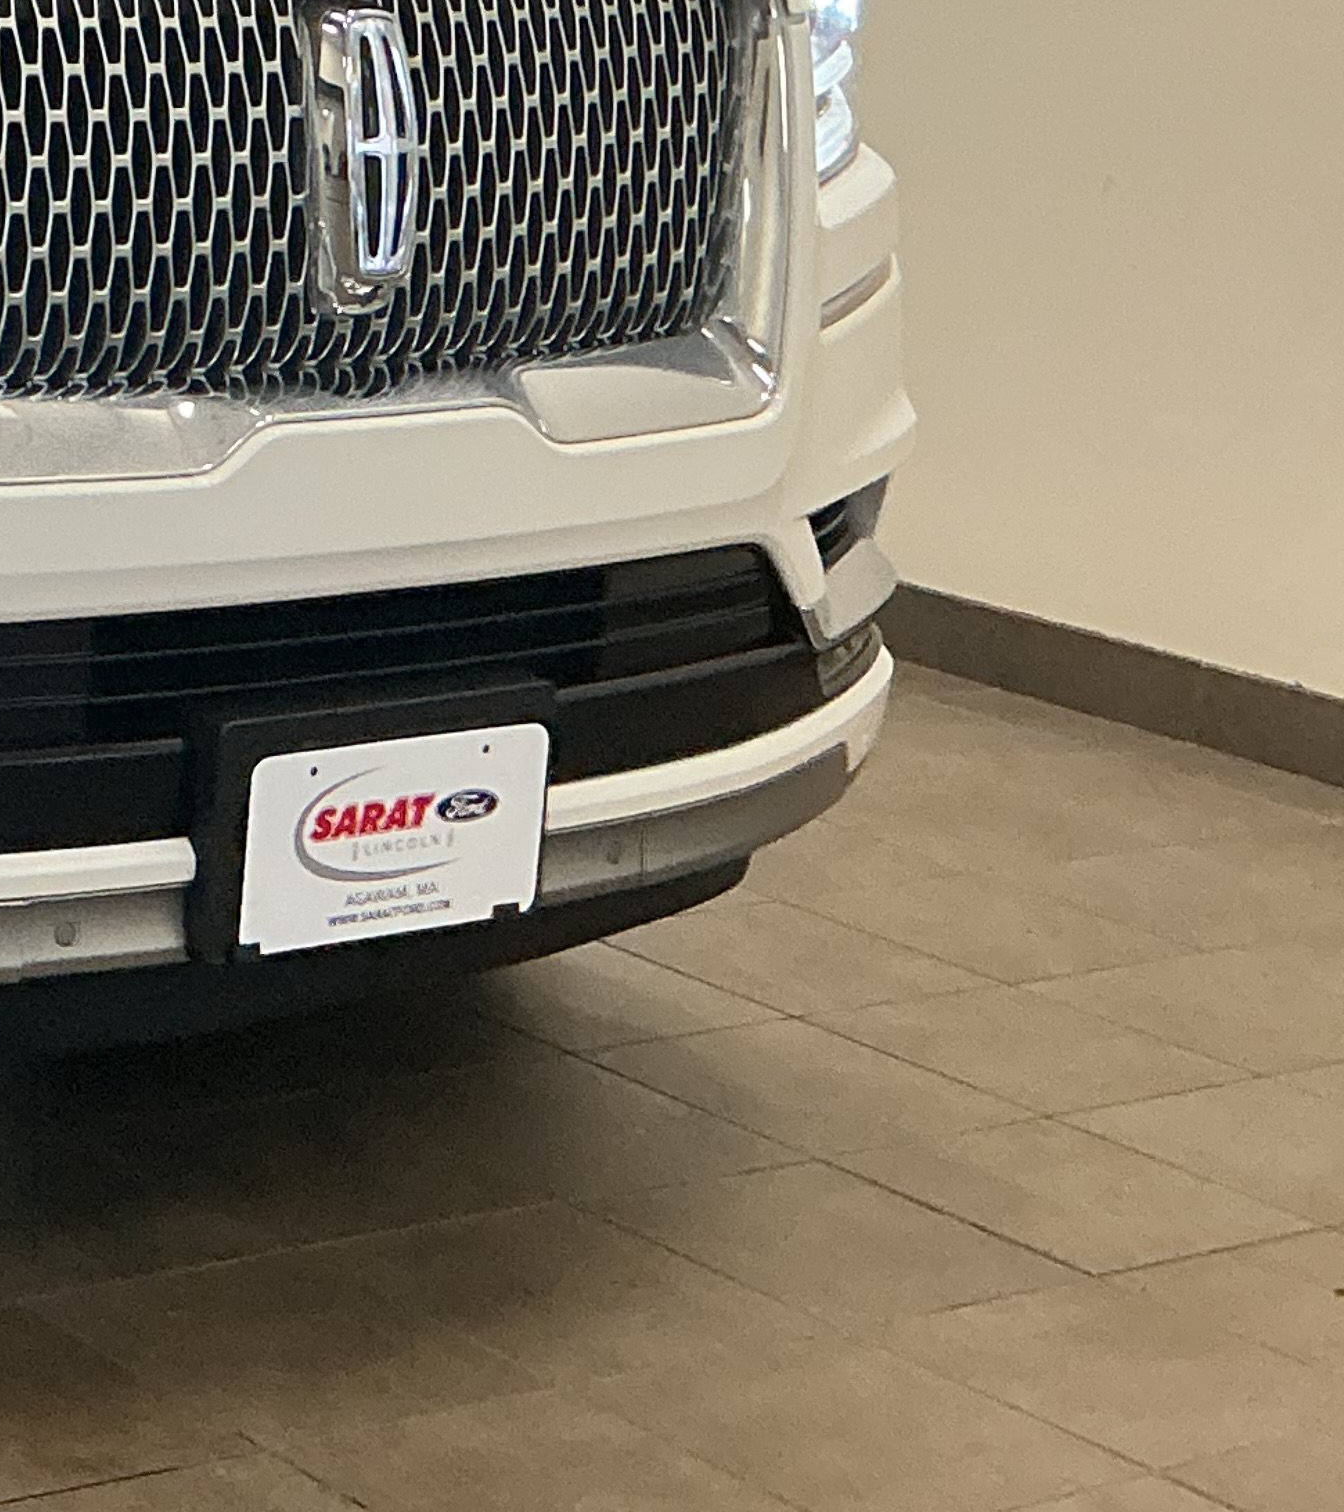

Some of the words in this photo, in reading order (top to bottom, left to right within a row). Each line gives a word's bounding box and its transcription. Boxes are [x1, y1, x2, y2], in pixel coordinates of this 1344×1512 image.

[310, 792, 437, 843] SARAT
[440, 790, 497, 821] Ford
[363, 834, 442, 856] LINCOLN
[416, 881, 439, 896] MA
